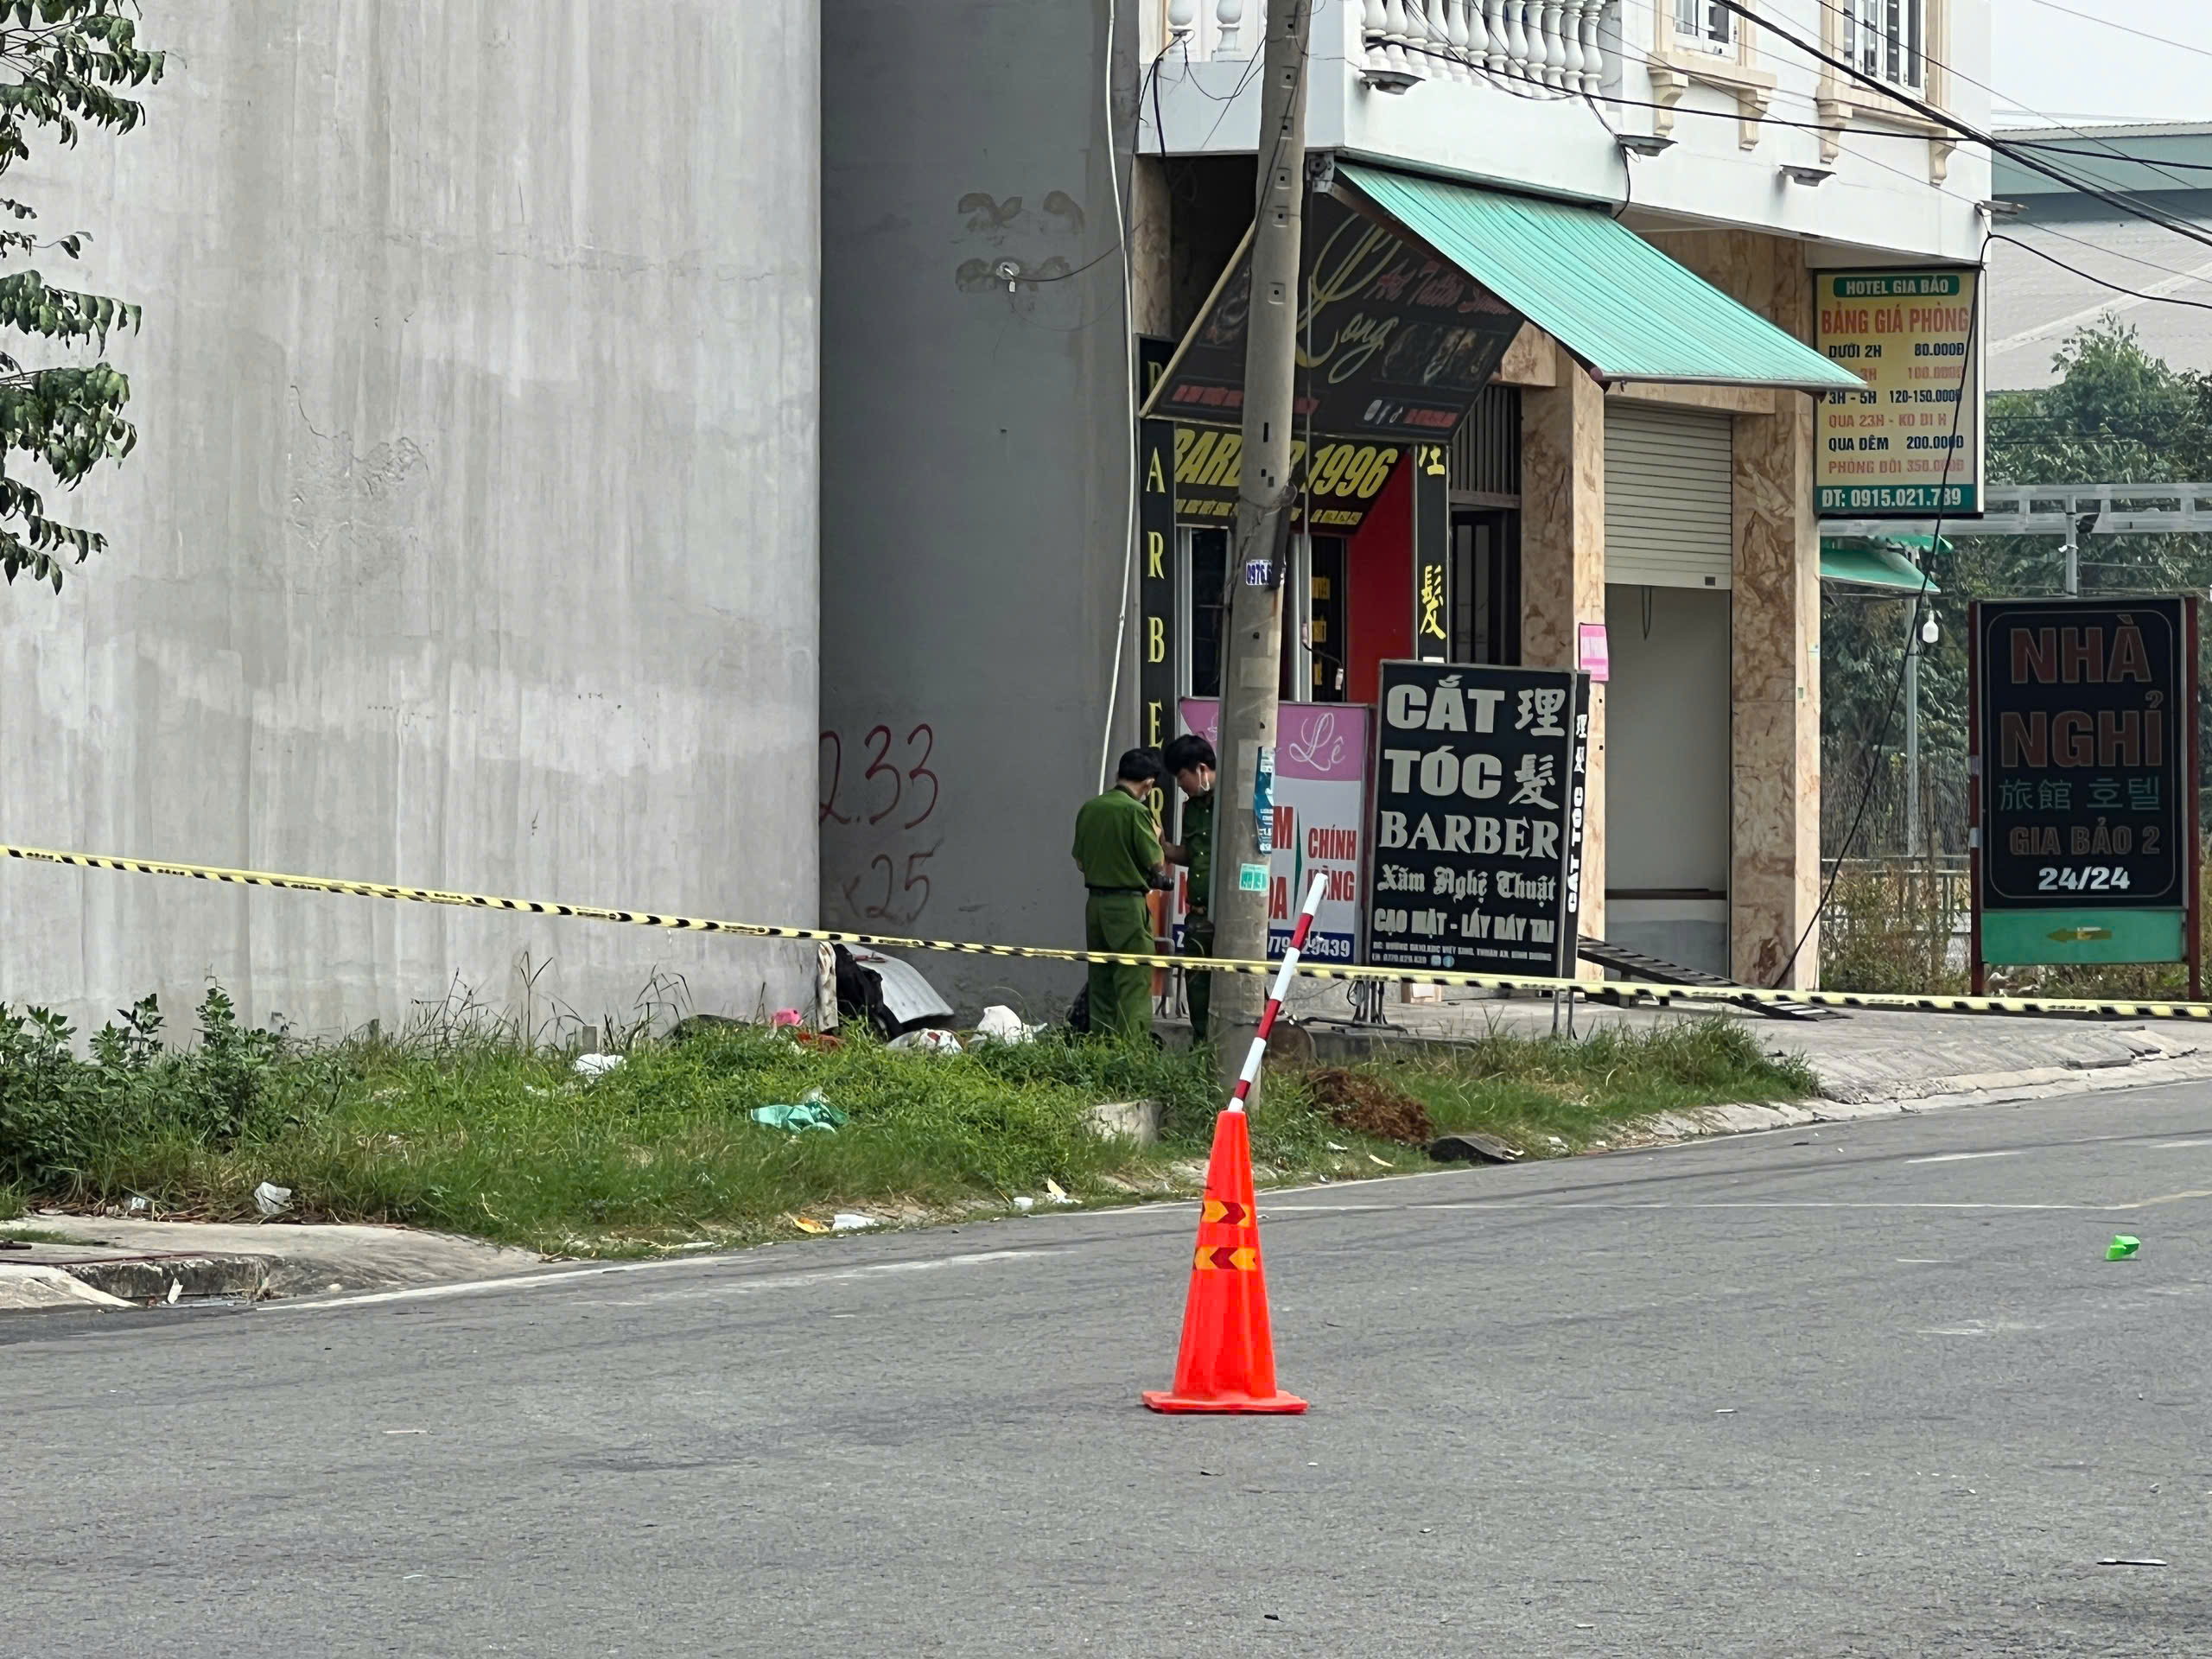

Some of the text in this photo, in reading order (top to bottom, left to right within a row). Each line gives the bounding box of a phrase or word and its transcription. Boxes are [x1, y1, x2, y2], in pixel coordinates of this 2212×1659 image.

[1846, 281, 1888, 295] HOTEL
[1892, 279, 1916, 294] GIA
[1821, 302, 1969, 334] BẢNG GIÁ PHÒNG
[1865, 344, 1882, 358] 2H
[1828, 391, 1847, 404] 3H
[1859, 390, 1877, 404] 5H
[1828, 413, 1855, 429] QUA
[1859, 413, 1885, 427] 23H
[1828, 437, 1855, 452] QUA
[1299, 442, 1399, 499] 1996
[2010, 613, 2152, 684] NHÀ
[1386, 674, 1506, 734] CẮT
[1999, 690, 2164, 768] NGHỈ
[1384, 745, 1503, 799] TÓC
[1999, 778, 2073, 812] 旅館
[2086, 777, 2161, 811] 호텔
[1307, 823, 1357, 861] CHÍNH
[1378, 810, 1560, 860] BARBER
[2009, 817, 2161, 856] GIA BẢO 2
[2037, 866, 2132, 892] 24/24
